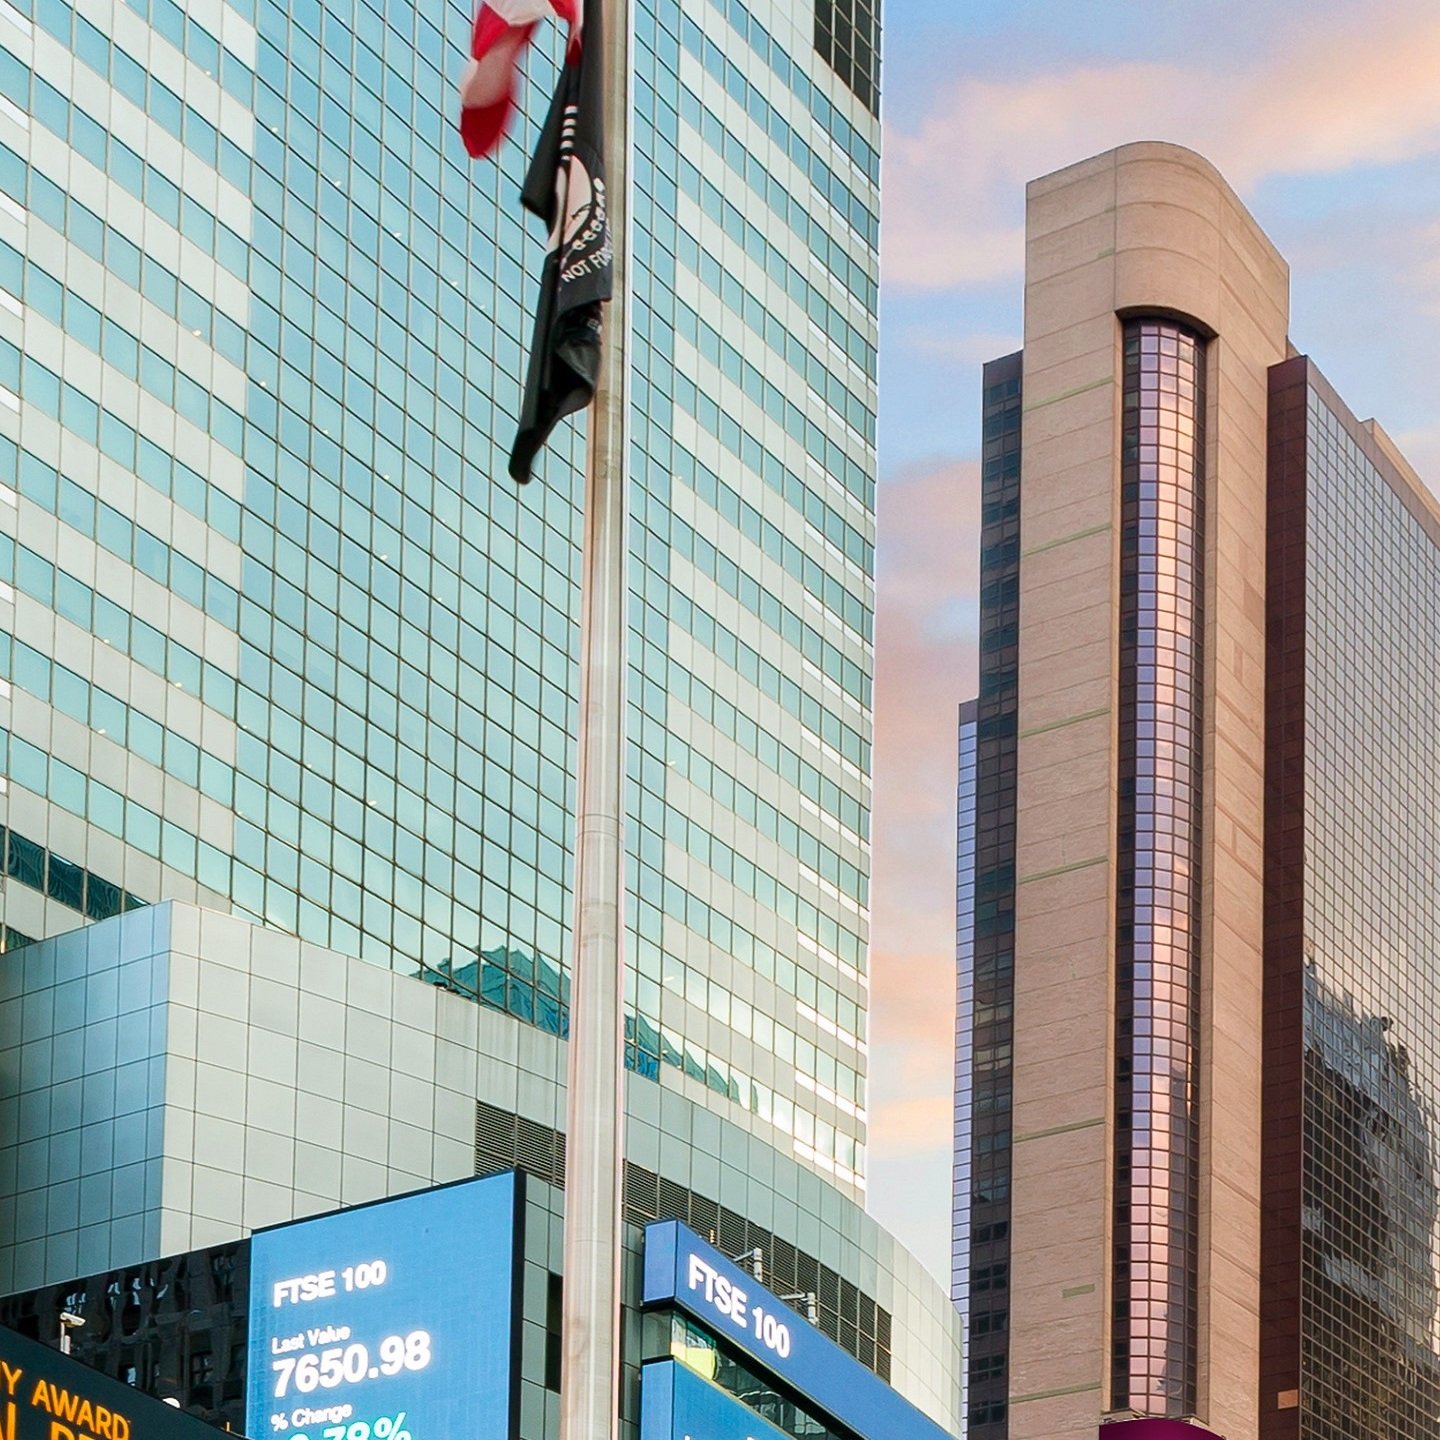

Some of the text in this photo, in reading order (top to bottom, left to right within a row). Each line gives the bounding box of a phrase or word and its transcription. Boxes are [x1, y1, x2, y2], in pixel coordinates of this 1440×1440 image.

[273, 1261, 387, 1307] FTSE 100
[689, 1253, 790, 1359] FTSE 100
[272, 1324, 351, 1354] Last Value
[273, 1331, 431, 1397] 7650.98
[292, 1402, 352, 1432] Change
